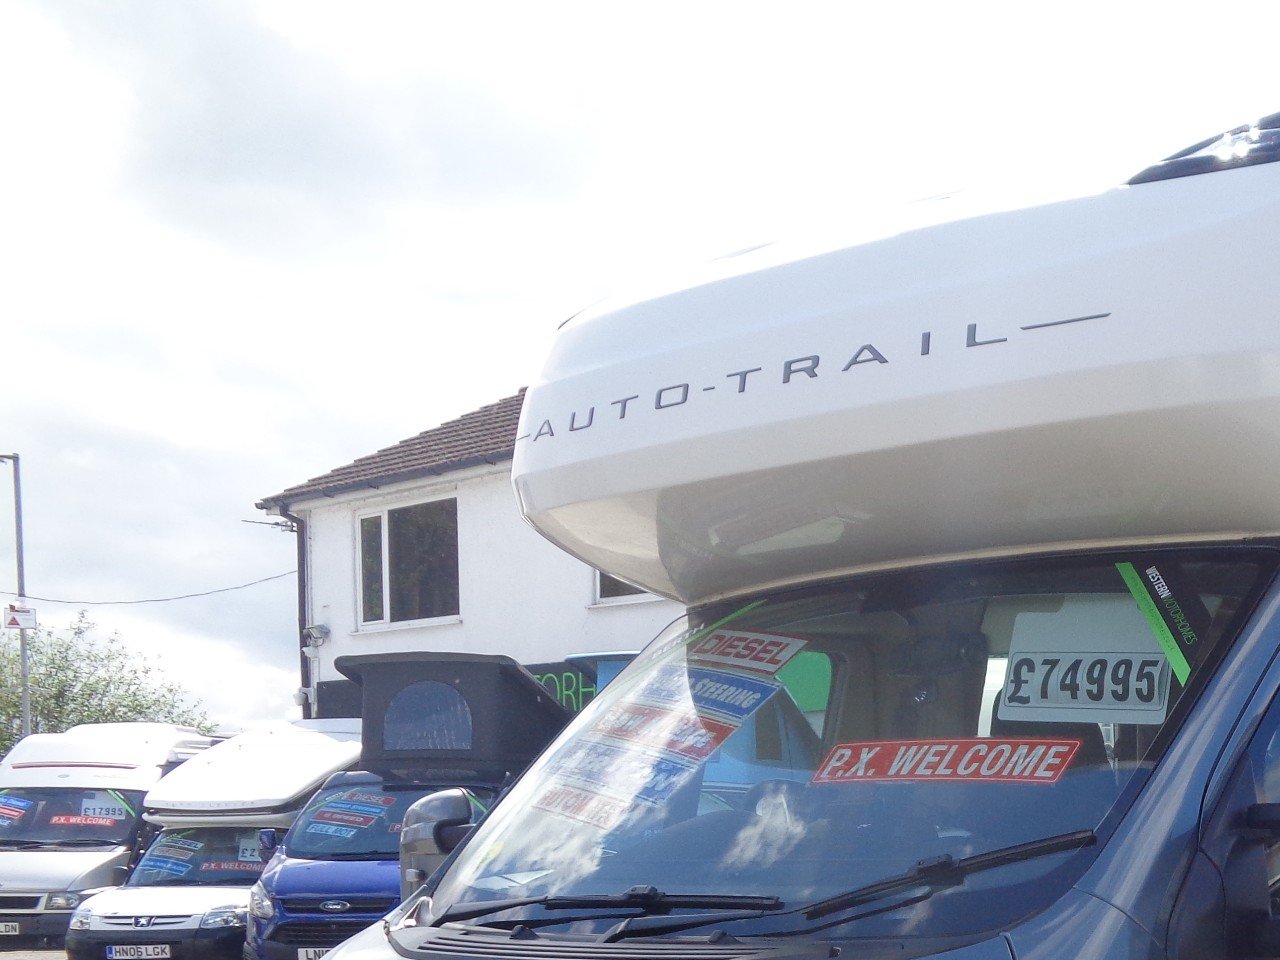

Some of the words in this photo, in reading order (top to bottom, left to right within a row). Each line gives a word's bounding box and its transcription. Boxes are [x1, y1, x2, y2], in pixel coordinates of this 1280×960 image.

[531, 322, 1008, 442] AUTO-TRAIL
[1145, 565, 1172, 599] WESTERN
[692, 633, 790, 666] DIESEL
[695, 677, 761, 709] STEERING
[1007, 657, 1160, 705] £74995
[820, 746, 881, 778] P.X.
[888, 744, 1070, 778] WELCOME
[69, 816, 113, 825] WELCOME
[83, 807, 123, 816] £17995
[144, 946, 168, 957] LGK
